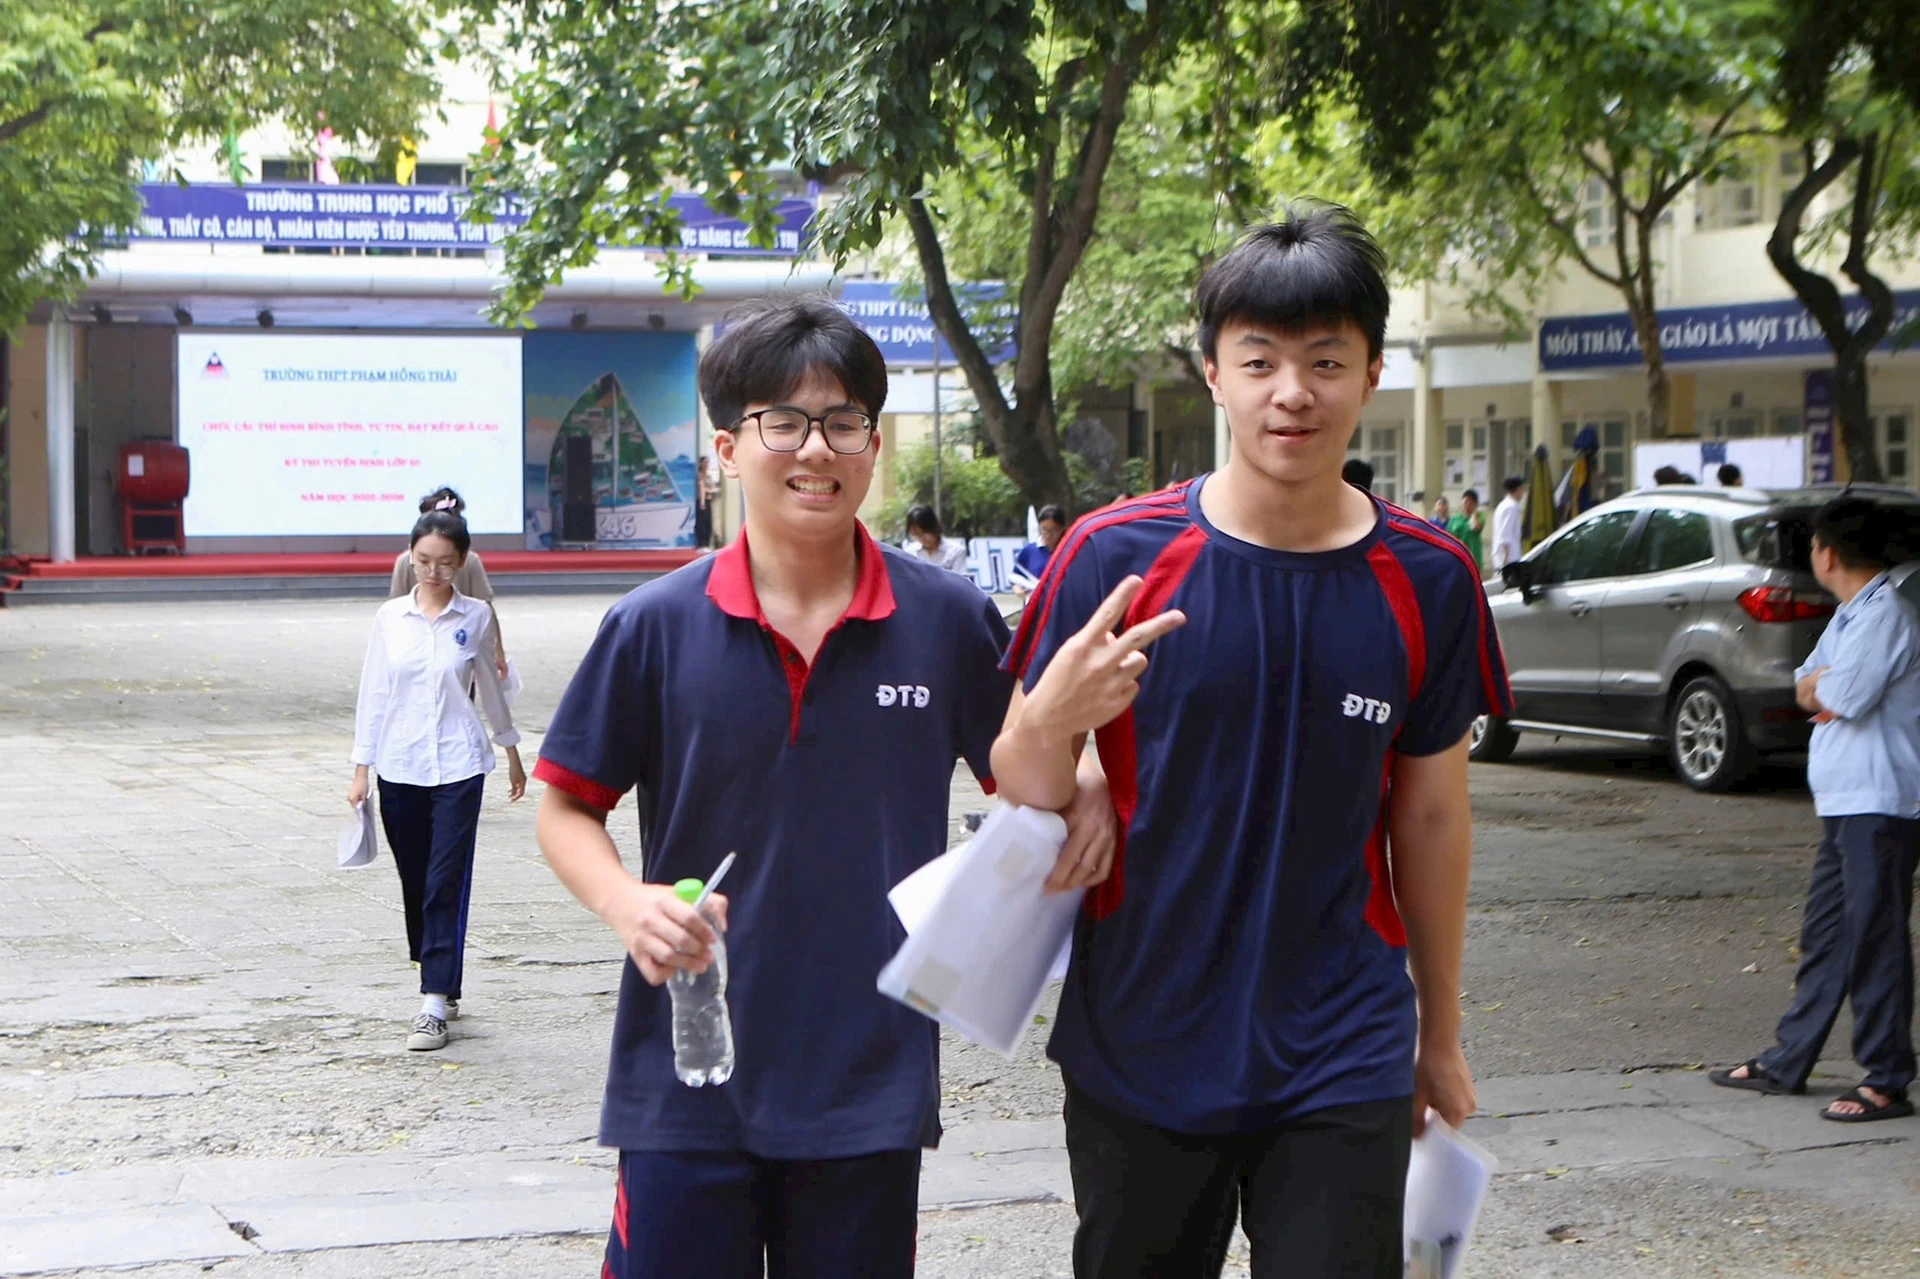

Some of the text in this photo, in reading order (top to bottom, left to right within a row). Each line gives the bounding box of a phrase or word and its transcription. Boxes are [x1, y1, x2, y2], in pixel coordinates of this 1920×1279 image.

[246, 188, 314, 212] TRƯỜNG
[316, 191, 373, 213] TRUNG
[376, 193, 410, 217] HỌC
[858, 300, 897, 317] THPT
[1659, 316, 1708, 349] GIÁO
[1737, 315, 1781, 350] MỘT
[262, 368, 314, 382] TRƯỜNG
[317, 369, 348, 382] THPT
[350, 369, 387, 384] PHẠM
[389, 367, 426, 383] HỒNG
[875, 684, 931, 708] ĐTĐ
[1341, 692, 1392, 724] ĐTĐ
